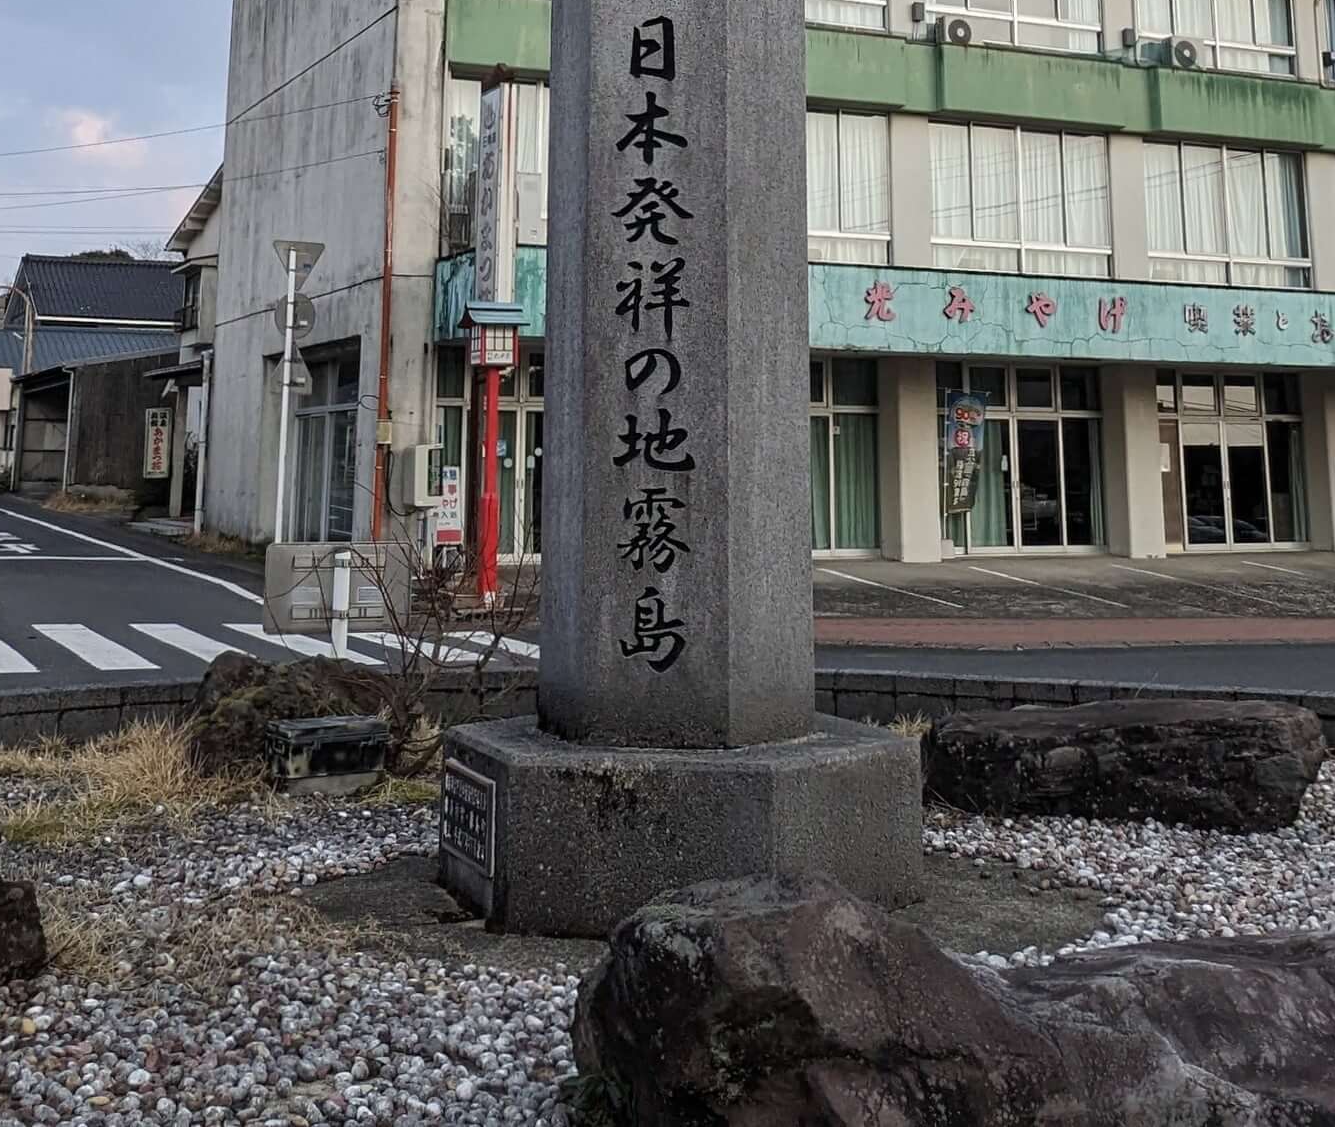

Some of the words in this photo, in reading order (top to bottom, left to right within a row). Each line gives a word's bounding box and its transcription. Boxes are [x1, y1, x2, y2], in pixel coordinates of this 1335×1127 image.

[612, 15, 696, 673] 日本発祥の地霧島
